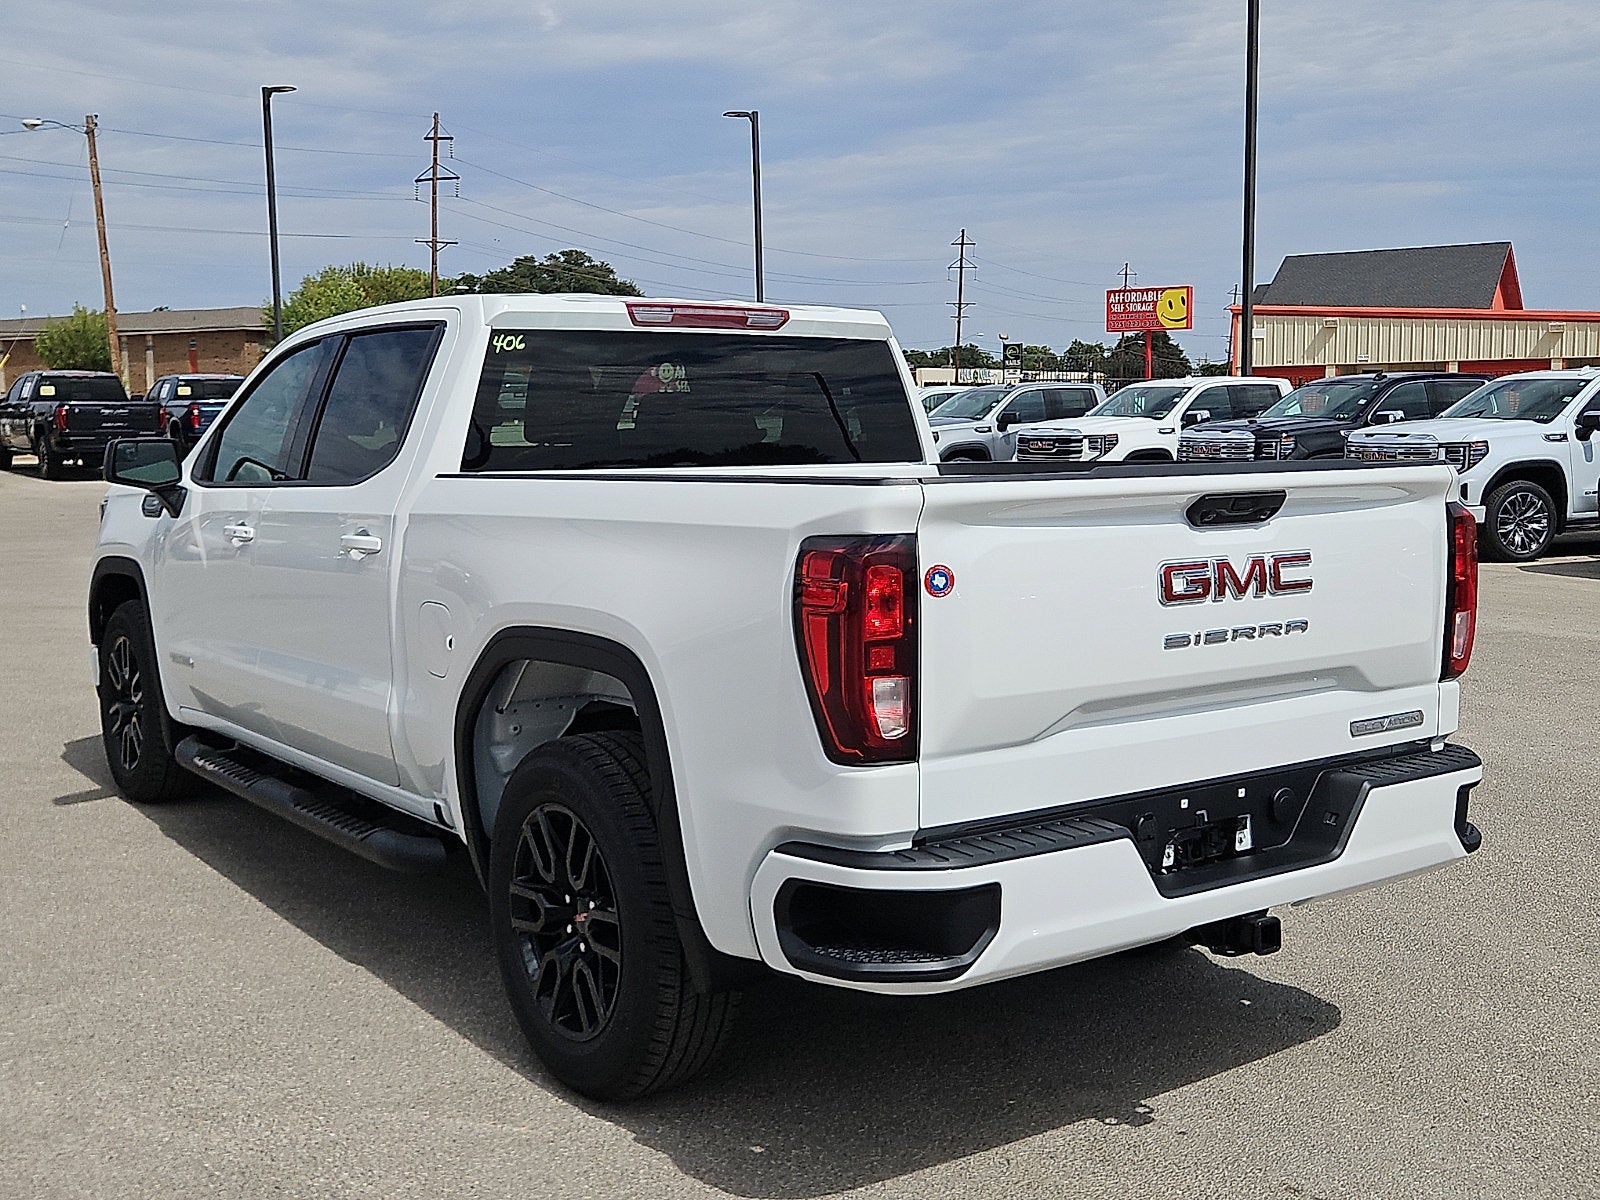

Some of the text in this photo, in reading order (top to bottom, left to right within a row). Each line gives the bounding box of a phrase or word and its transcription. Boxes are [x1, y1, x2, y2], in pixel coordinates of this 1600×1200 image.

[1109, 290, 1163, 303] AFFORDABLE
[1111, 302, 1154, 313] SELF STORAGE
[493, 334, 526, 354] 406
[1157, 549, 1314, 608] GMC
[1163, 619, 1309, 650] SIERRA
